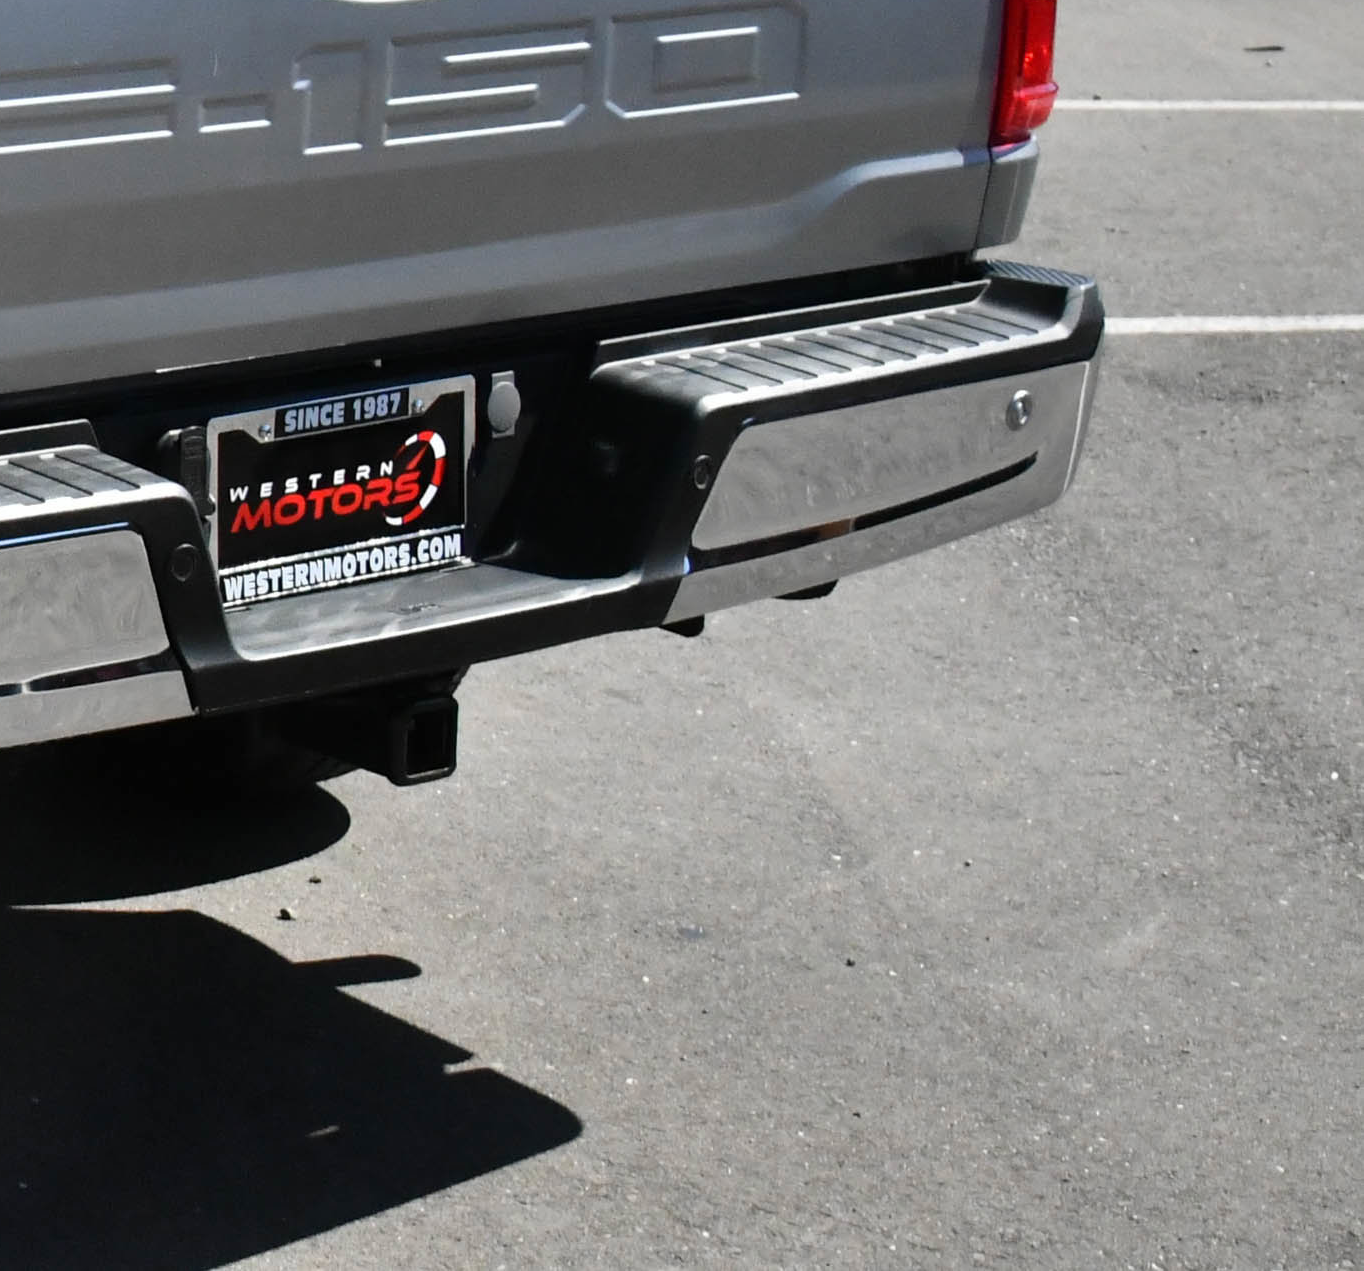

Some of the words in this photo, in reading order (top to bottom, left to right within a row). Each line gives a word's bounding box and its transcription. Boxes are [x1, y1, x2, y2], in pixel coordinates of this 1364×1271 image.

[284, 402, 344, 433] SINCE
[353, 392, 402, 422] 1987
[229, 460, 393, 503] WESTERN
[230, 471, 422, 534] MOTORS
[223, 533, 462, 602] WESTERNMOTORS.COM
